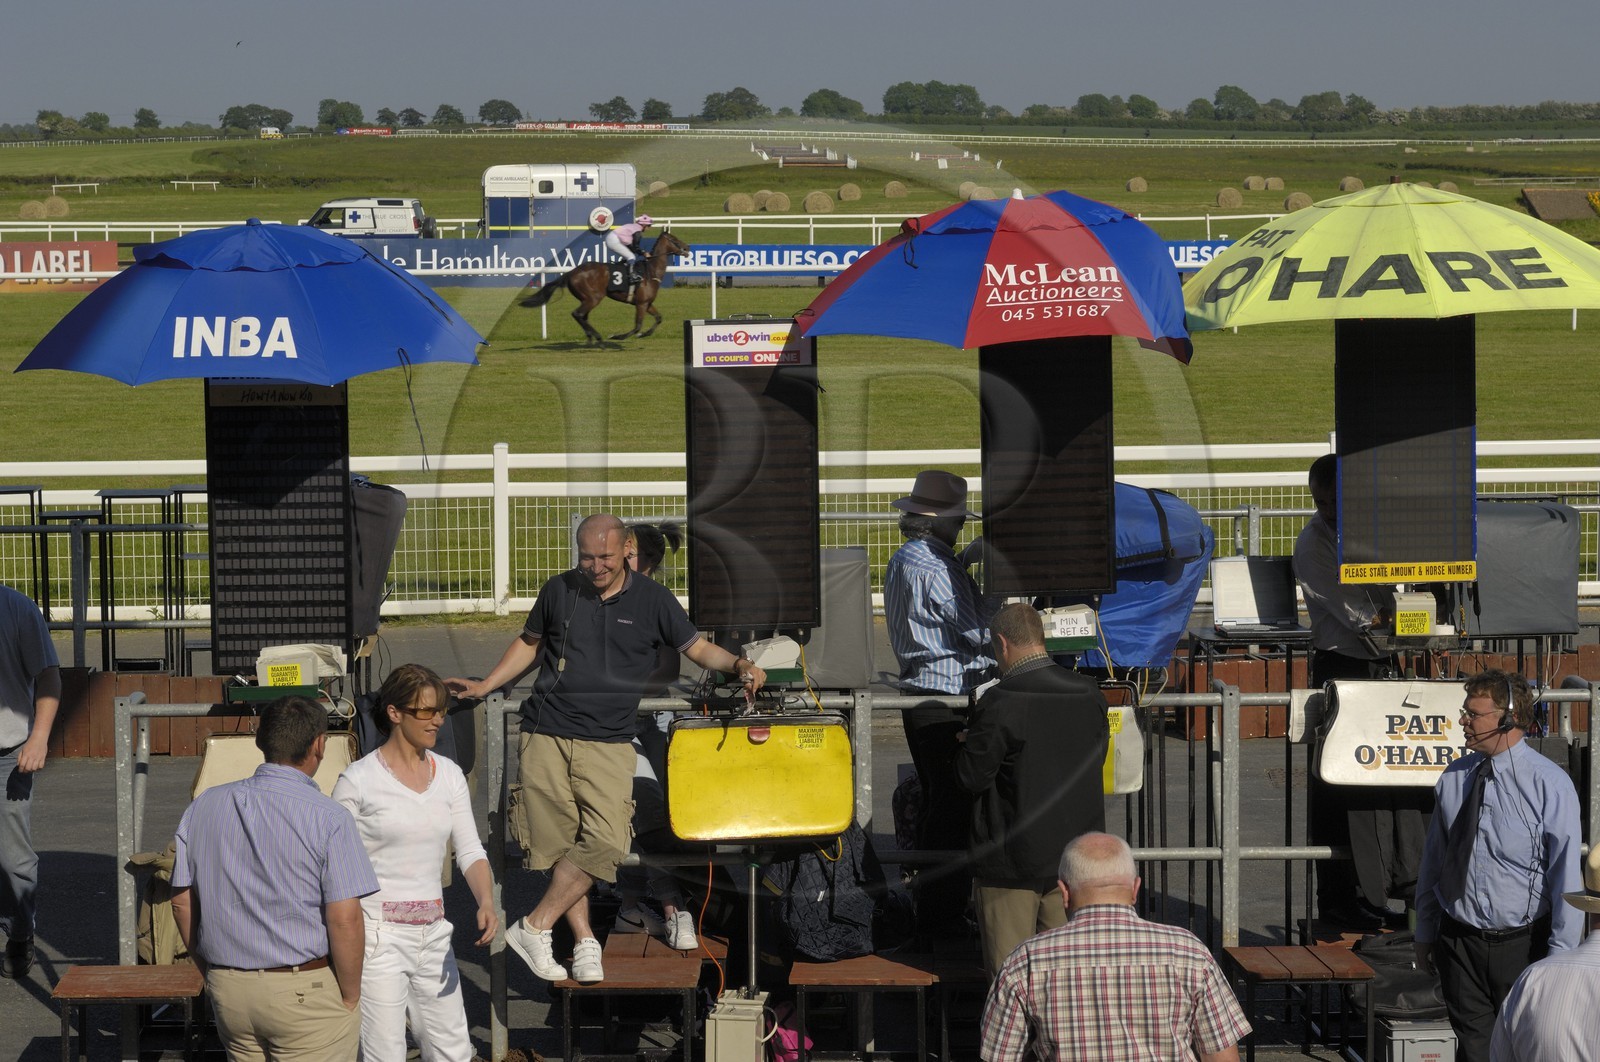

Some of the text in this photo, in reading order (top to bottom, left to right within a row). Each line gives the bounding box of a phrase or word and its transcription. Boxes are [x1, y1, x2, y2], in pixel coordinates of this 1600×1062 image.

[1239, 228, 1296, 249] PAT
[14, 250, 98, 283] LABEL
[415, 244, 546, 277] Hamilton
[612, 271, 624, 286] 3
[984, 263, 1120, 286] McLean
[1204, 246, 1568, 303] O'HARE
[986, 285, 1123, 303] Auctioneers
[1002, 305, 1111, 322] 045 531687
[172, 316, 298, 358] INBA
[705, 352, 798, 363] on course ONLINE
[1345, 564, 1473, 578] PLEASE STATE AMOUNT & HORSE NUMBER
[1060, 617, 1078, 625] MIN
[1060, 628, 1077, 636] BET
[1385, 714, 1450, 738] PAT
